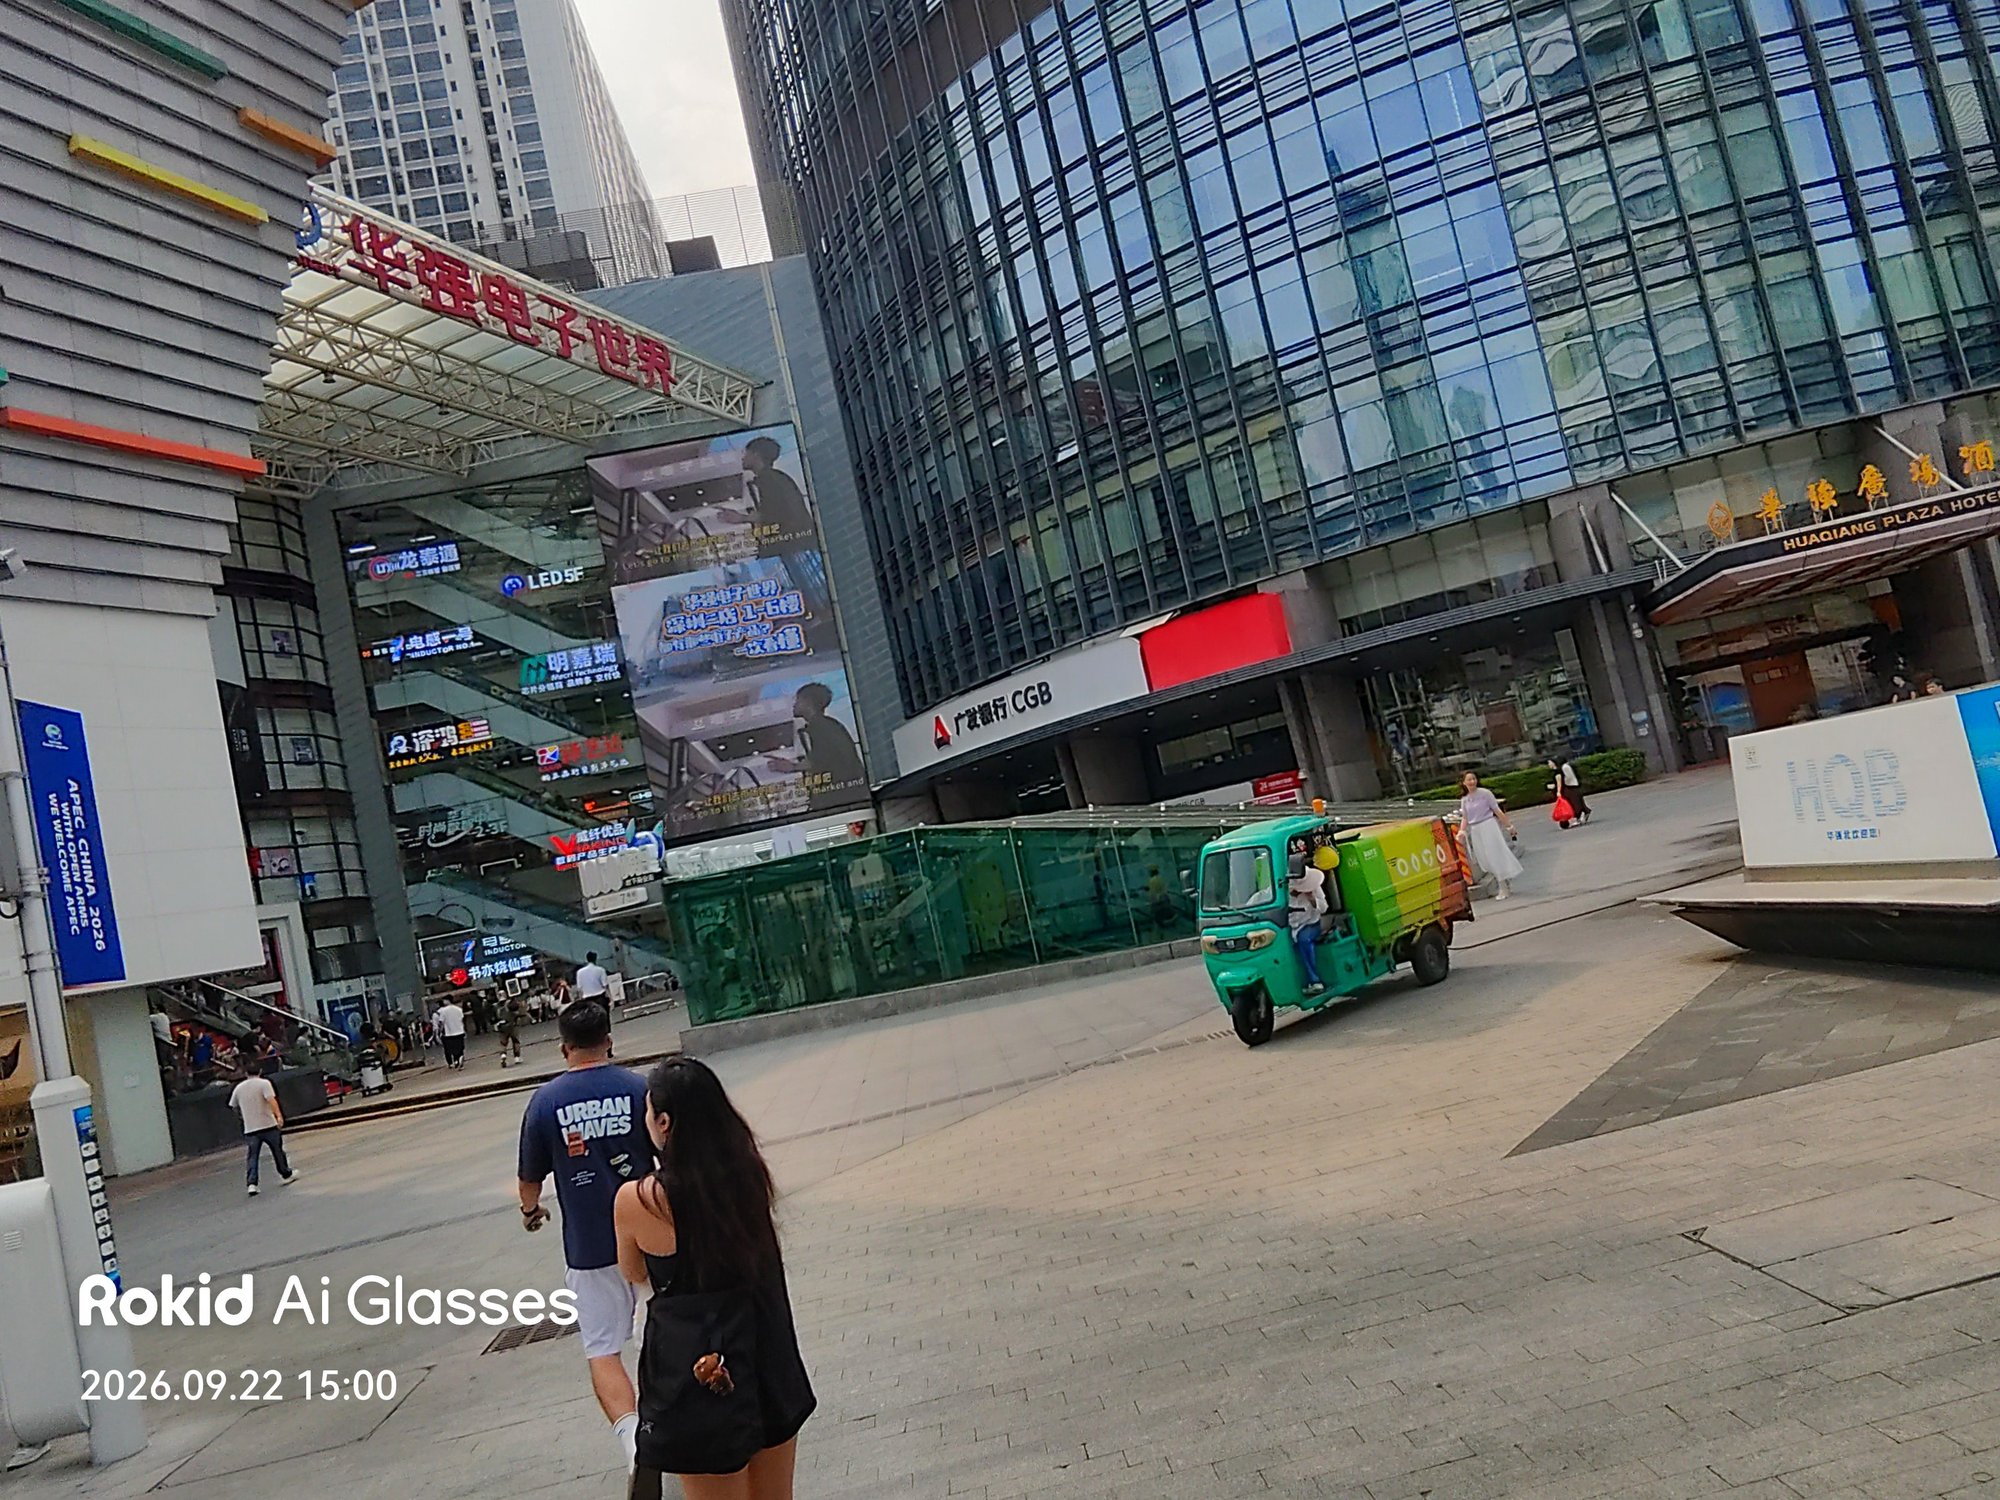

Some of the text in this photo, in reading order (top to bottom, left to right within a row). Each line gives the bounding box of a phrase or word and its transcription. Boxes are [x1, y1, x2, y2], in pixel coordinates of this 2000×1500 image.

[341, 214, 678, 397] 华强电子世界
[796, 529, 812, 537] and
[1783, 520, 1876, 550] HUAQIANG
[1883, 505, 1945, 527] PLAZA
[399, 544, 459, 569] 龙泰通
[683, 580, 779, 609] 华强电子世界
[409, 626, 473, 649] 电感一号
[548, 643, 617, 673] 明嘉瑞
[576, 664, 618, 678] Technology
[954, 681, 1052, 736] 广发银行 CGB
[848, 777, 864, 786] and
[48, 792, 80, 935] WE WELCOME APEC
[60, 801, 88, 927] WITH OPEN ARMS
[67, 779, 106, 951] APEC CHINA 2026
[468, 956, 533, 979] 书亦烧仙草
[556, 1096, 631, 1127] URBAN
[561, 1116, 632, 1145] WAVES
